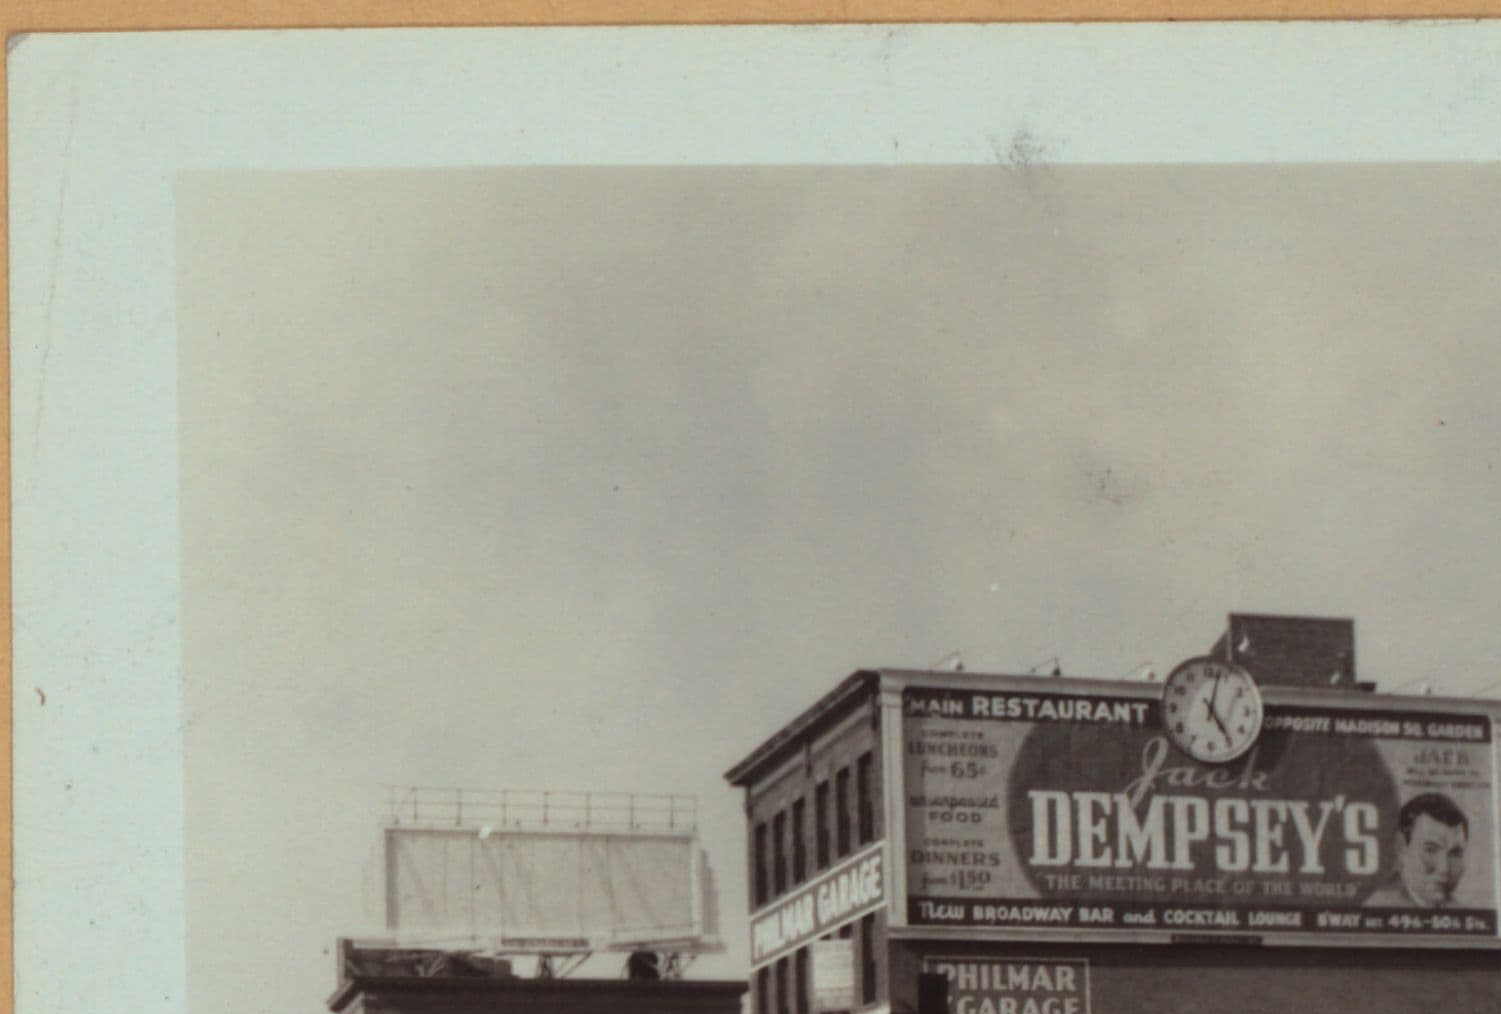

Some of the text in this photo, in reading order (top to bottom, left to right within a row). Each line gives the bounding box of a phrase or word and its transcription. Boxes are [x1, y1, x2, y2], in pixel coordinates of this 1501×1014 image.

[908, 698, 962, 716] MAIN
[972, 695, 1150, 723] RESTAURANT
[1263, 715, 1330, 732] OPPOSITE
[1335, 719, 1400, 735] MADISON
[1427, 722, 1484, 740] GARDEN
[908, 742, 998, 758] LUNCHEONS
[1122, 736, 1271, 808] Jack
[928, 811, 982, 823] FOOD
[1027, 789, 1380, 875] DEMPSEY'S
[910, 850, 1000, 867] DINNERS
[817, 855, 882, 926] GARAGE
[1089, 874, 1165, 893] MEETING
[1171, 877, 1225, 894] PLACE
[1233, 879, 1255, 894] OF
[1263, 881, 1291, 896] THE
[920, 901, 965, 919] New
[973, 905, 1073, 922] BROADWAY
[1079, 907, 1114, 922] BAR
[1123, 909, 1157, 925] and
[1163, 909, 1240, 927] COCKTAIL
[1247, 911, 1301, 928] LOUNGE
[937, 963, 1077, 991] PHILMAR
